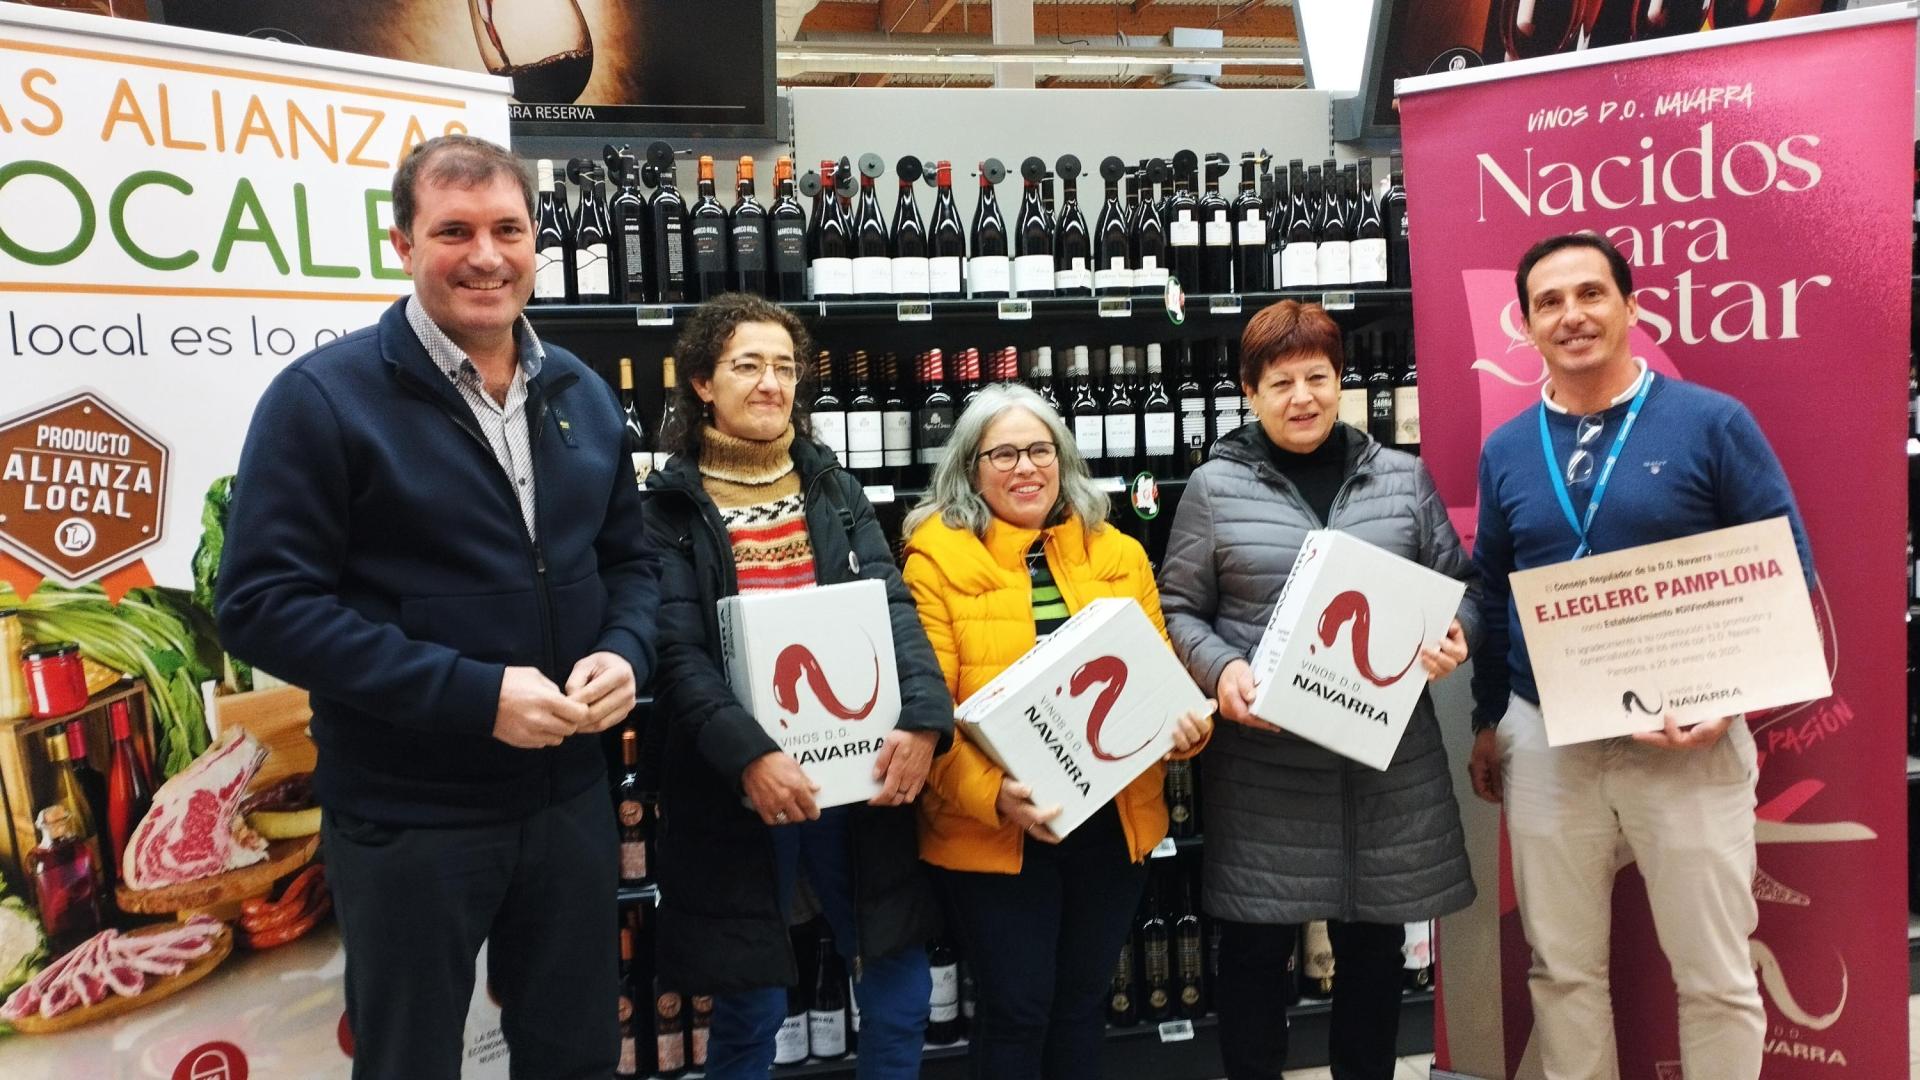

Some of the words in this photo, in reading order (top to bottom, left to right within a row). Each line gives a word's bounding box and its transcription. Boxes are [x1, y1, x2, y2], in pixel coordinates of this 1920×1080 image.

[0, 68, 63, 137] S
[101, 77, 468, 171] ALIANZA
[536, 106, 595, 120] RESERVA
[1600, 99, 1645, 122] D.O.
[1655, 82, 1755, 118] NAVARRA
[1476, 122, 1822, 223] Nacidos
[1566, 217, 1730, 268] ara
[9, 310, 149, 358] local
[170, 325, 232, 357] es
[251, 315, 299, 357] lo
[37, 425, 131, 458] PRODUCTO
[2, 453, 153, 495] ALIANZA
[24, 483, 132, 519] LOCAL
[1535, 585, 1649, 624] E.LECLERC
[1655, 559, 1783, 600] PAMPLONA
[1554, 577, 1588, 592] Consejo
[1588, 569, 1632, 584] Regulador
[1635, 566, 1646, 576] de
[1648, 563, 1656, 573] la
[1677, 553, 1712, 567] Navarra
[1301, 659, 1336, 684] VINOS
[1040, 695, 1066, 731] VINOS
[1292, 674, 1389, 726] NAVARRA
[1669, 687, 1743, 708] NAVARRA
[781, 728, 819, 748] VINOS
[824, 727, 850, 739] D.O.
[1024, 705, 1092, 798] NAVARRA
